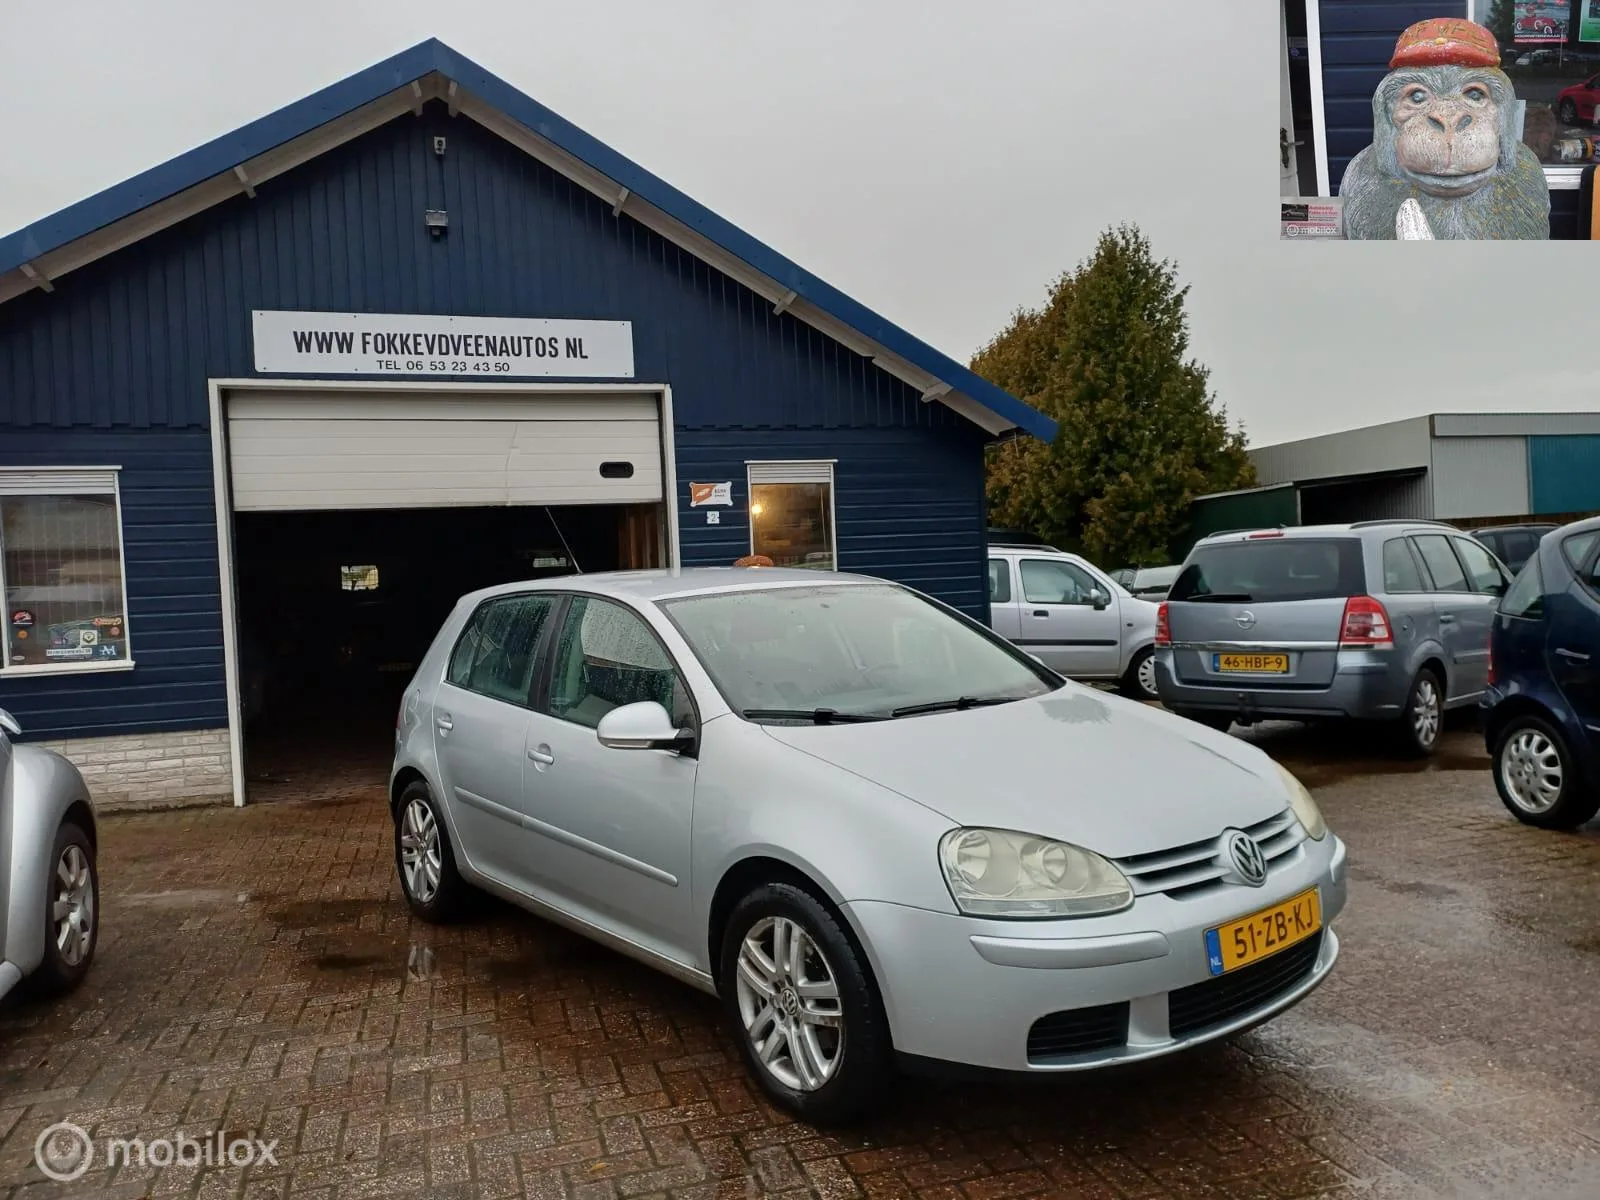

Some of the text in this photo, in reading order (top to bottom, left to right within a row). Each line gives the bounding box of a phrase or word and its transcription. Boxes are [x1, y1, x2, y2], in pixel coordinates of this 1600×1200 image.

[293, 331, 589, 359] WWW FOKKEVDVEENAUTOS NL
[376, 359, 510, 372] TEL 06 53 23 43 50
[1223, 656, 1283, 669] 46-HBF-9
[1233, 898, 1314, 960] 51-ZB-KJ
[1210, 956, 1222, 967] NL
